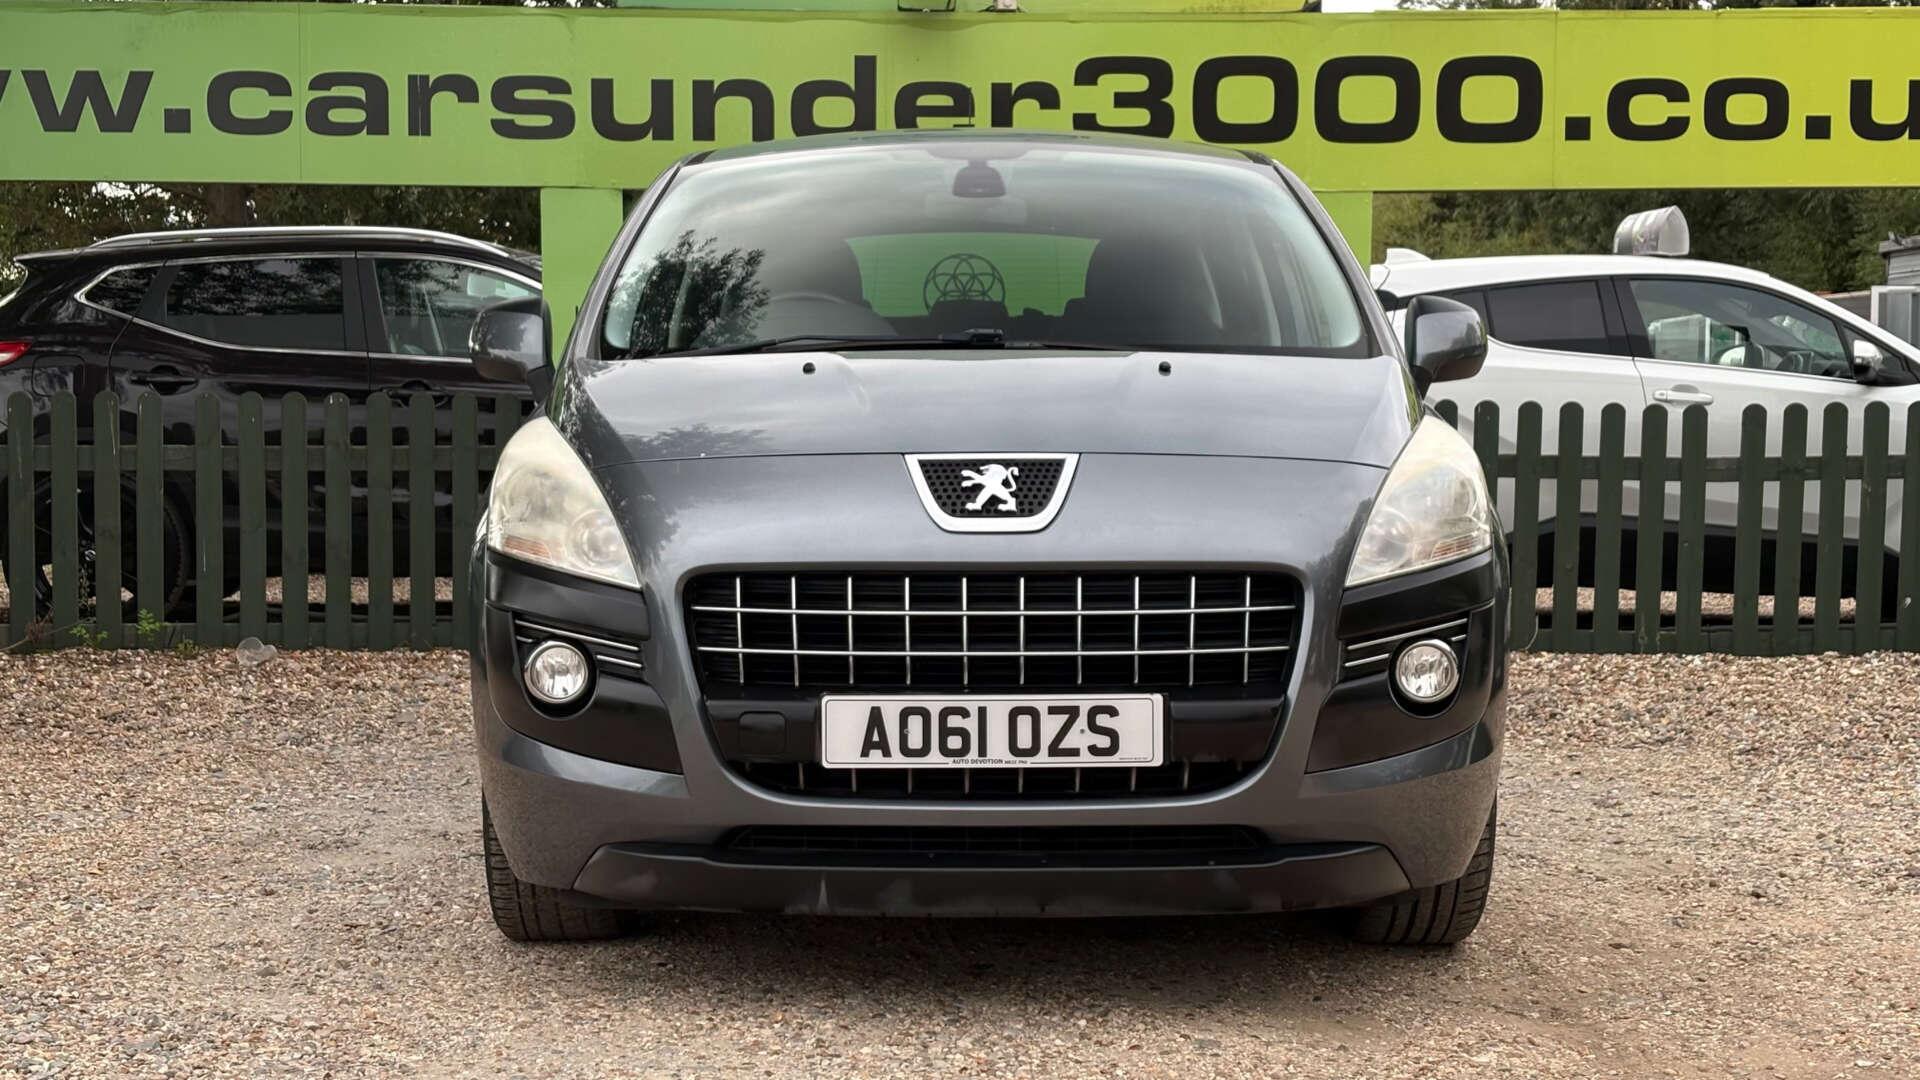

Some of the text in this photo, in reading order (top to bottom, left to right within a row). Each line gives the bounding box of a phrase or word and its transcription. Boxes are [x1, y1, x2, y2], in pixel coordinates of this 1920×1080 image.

[0, 55, 1920, 144] w.carsunder3000.co.u
[860, 705, 1120, 758] AO61 OZS
